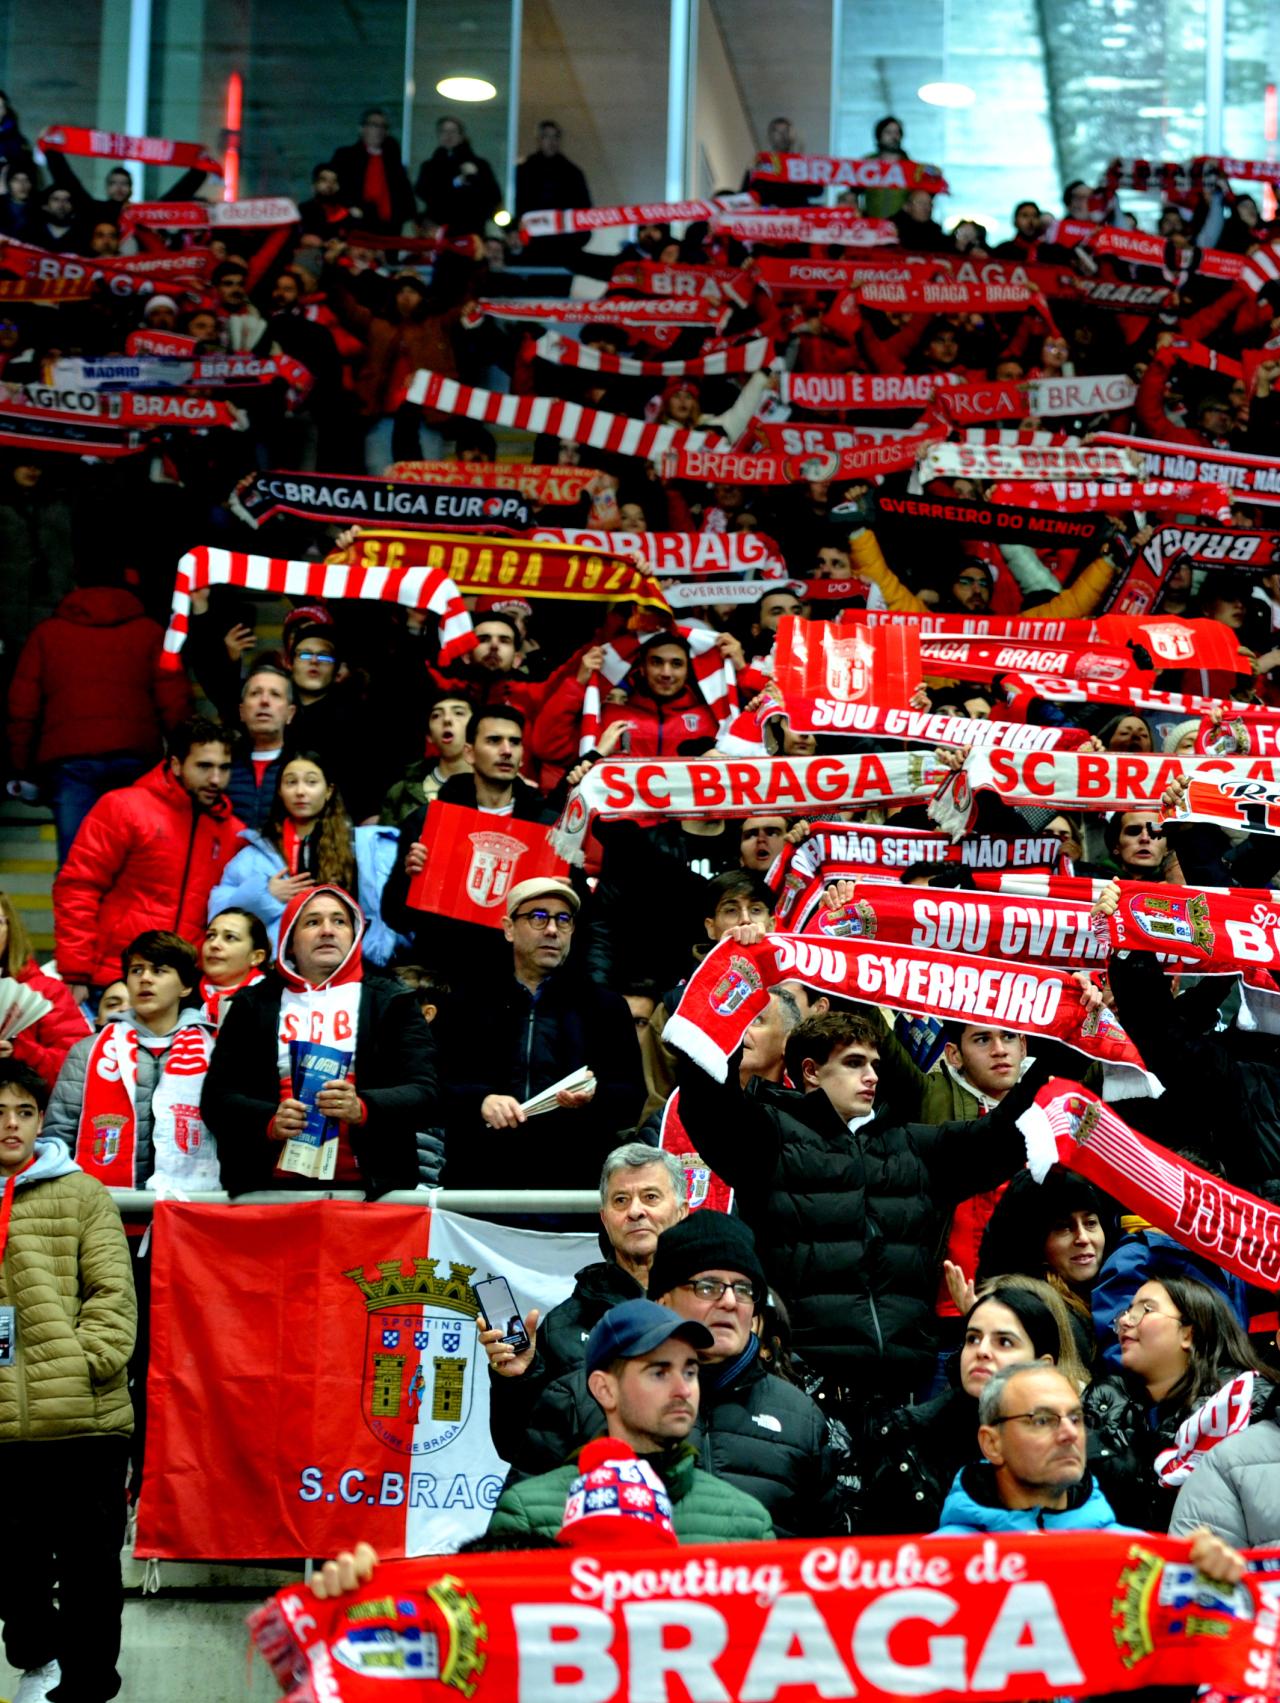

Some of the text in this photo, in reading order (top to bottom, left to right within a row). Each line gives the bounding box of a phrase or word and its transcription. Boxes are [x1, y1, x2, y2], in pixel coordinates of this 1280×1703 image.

[786, 159, 906, 187] BRAGA
[789, 265, 912, 284] FORÇA BRAGA
[861, 284, 1031, 304] BRAGA BRAGA BRAGA
[82, 360, 277, 379] MADRID BRAGA
[792, 377, 847, 404] AQUI
[132, 395, 218, 419] BRAGA
[685, 454, 777, 482] BRAGA
[1021, 449, 1123, 470] BRAGA
[879, 499, 1097, 539] GVERREIRO DO MINHO
[920, 642, 1070, 675] AGA BRAGA
[600, 756, 893, 808] SC BRAGA
[989, 749, 1055, 795] SC
[829, 830, 877, 865] NÃO
[960, 834, 1008, 869] NÃO
[911, 899, 991, 958] SOU
[771, 936, 1063, 1028] SOU GVERREIRO
[381, 1316, 463, 1332] SPORTING
[570, 1539, 1029, 1614] Sporting Clube de
[511, 1580, 1088, 1703] BRAGA
